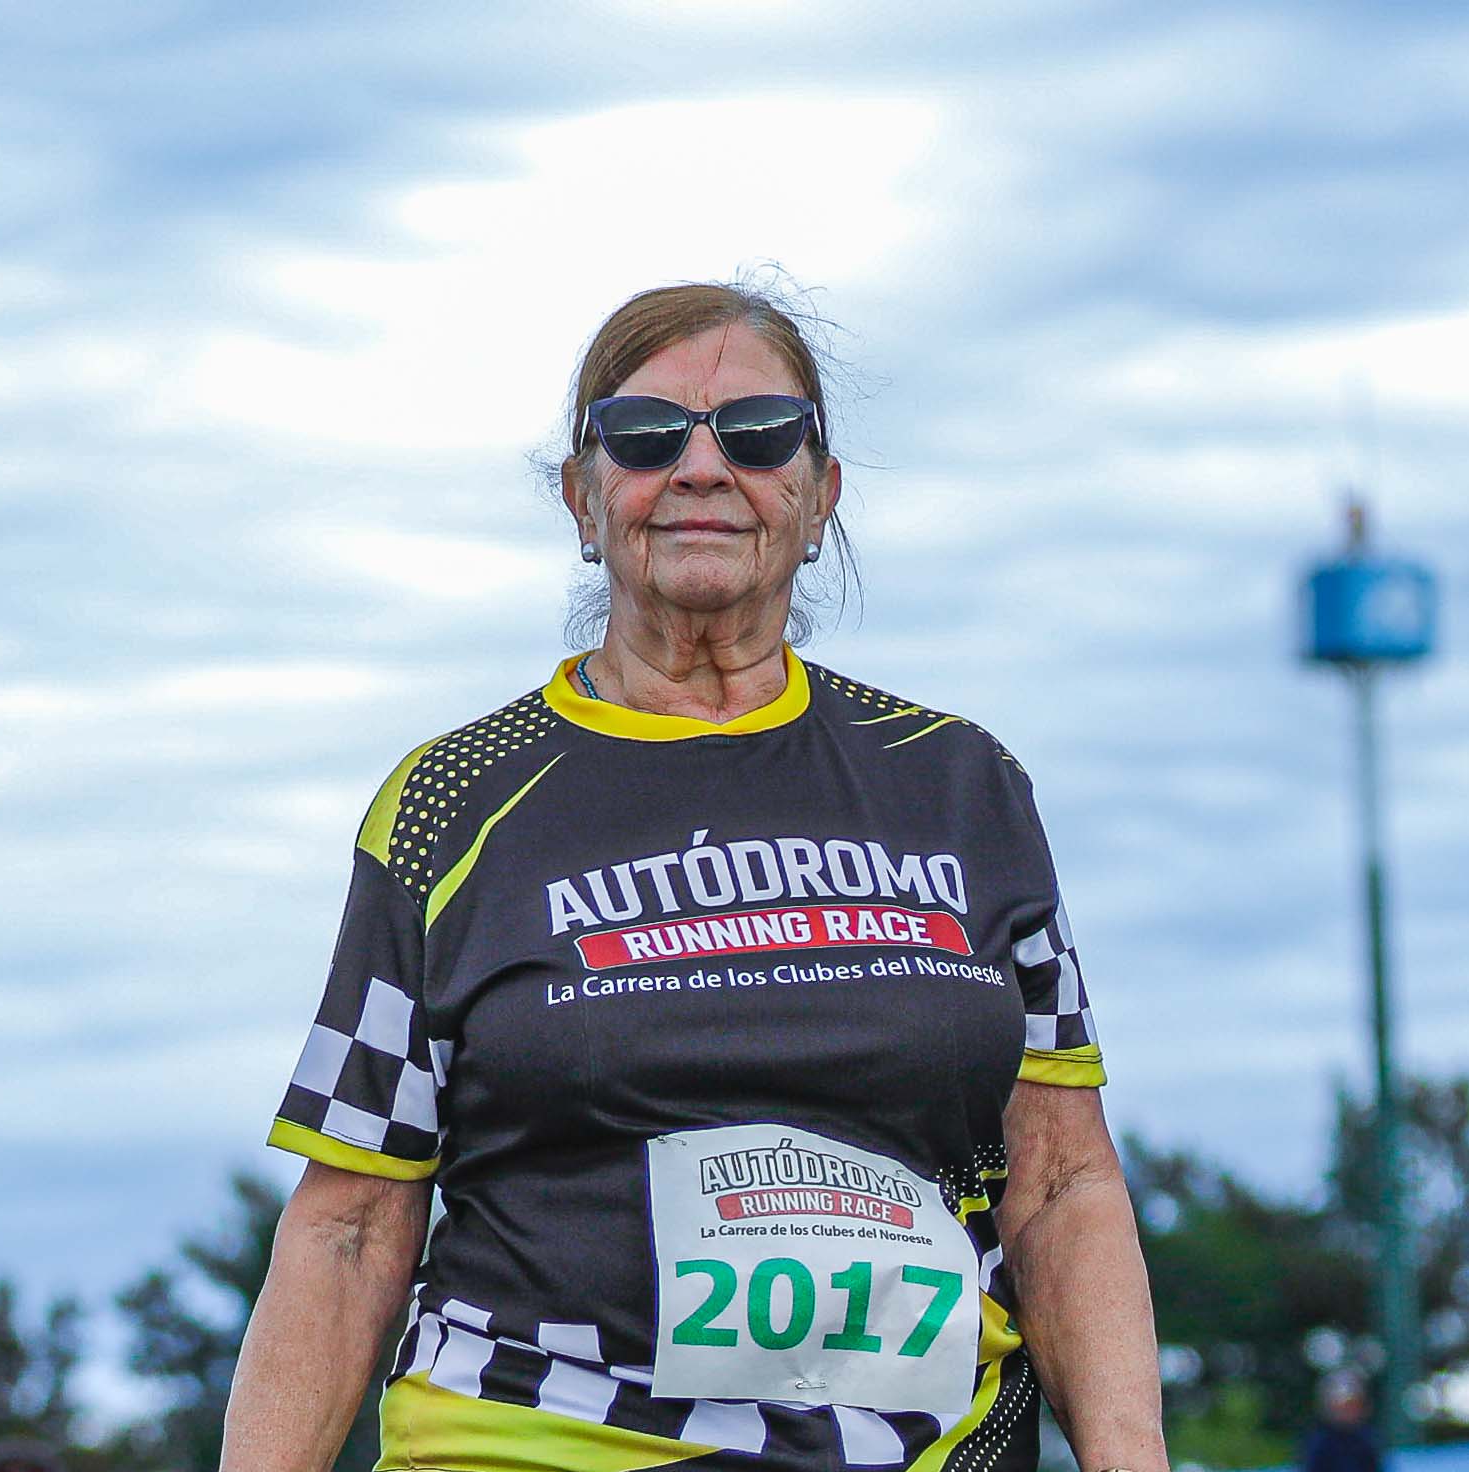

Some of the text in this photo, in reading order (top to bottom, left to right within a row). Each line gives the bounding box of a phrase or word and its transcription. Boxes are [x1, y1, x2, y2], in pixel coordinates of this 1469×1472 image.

[545, 829, 969, 936] AUTÓDROMO
[622, 909, 933, 961] RUNNING RACE
[547, 956, 1006, 1006] La Carrera de los Clubes del Noroeste
[699, 1138, 923, 1209] AUTÓDROMO
[739, 1188, 893, 1222] RUNNING RACE
[700, 1223, 933, 1246] La Carrera de los Clubes del Noroeste
[672, 1257, 963, 1358] 2017
